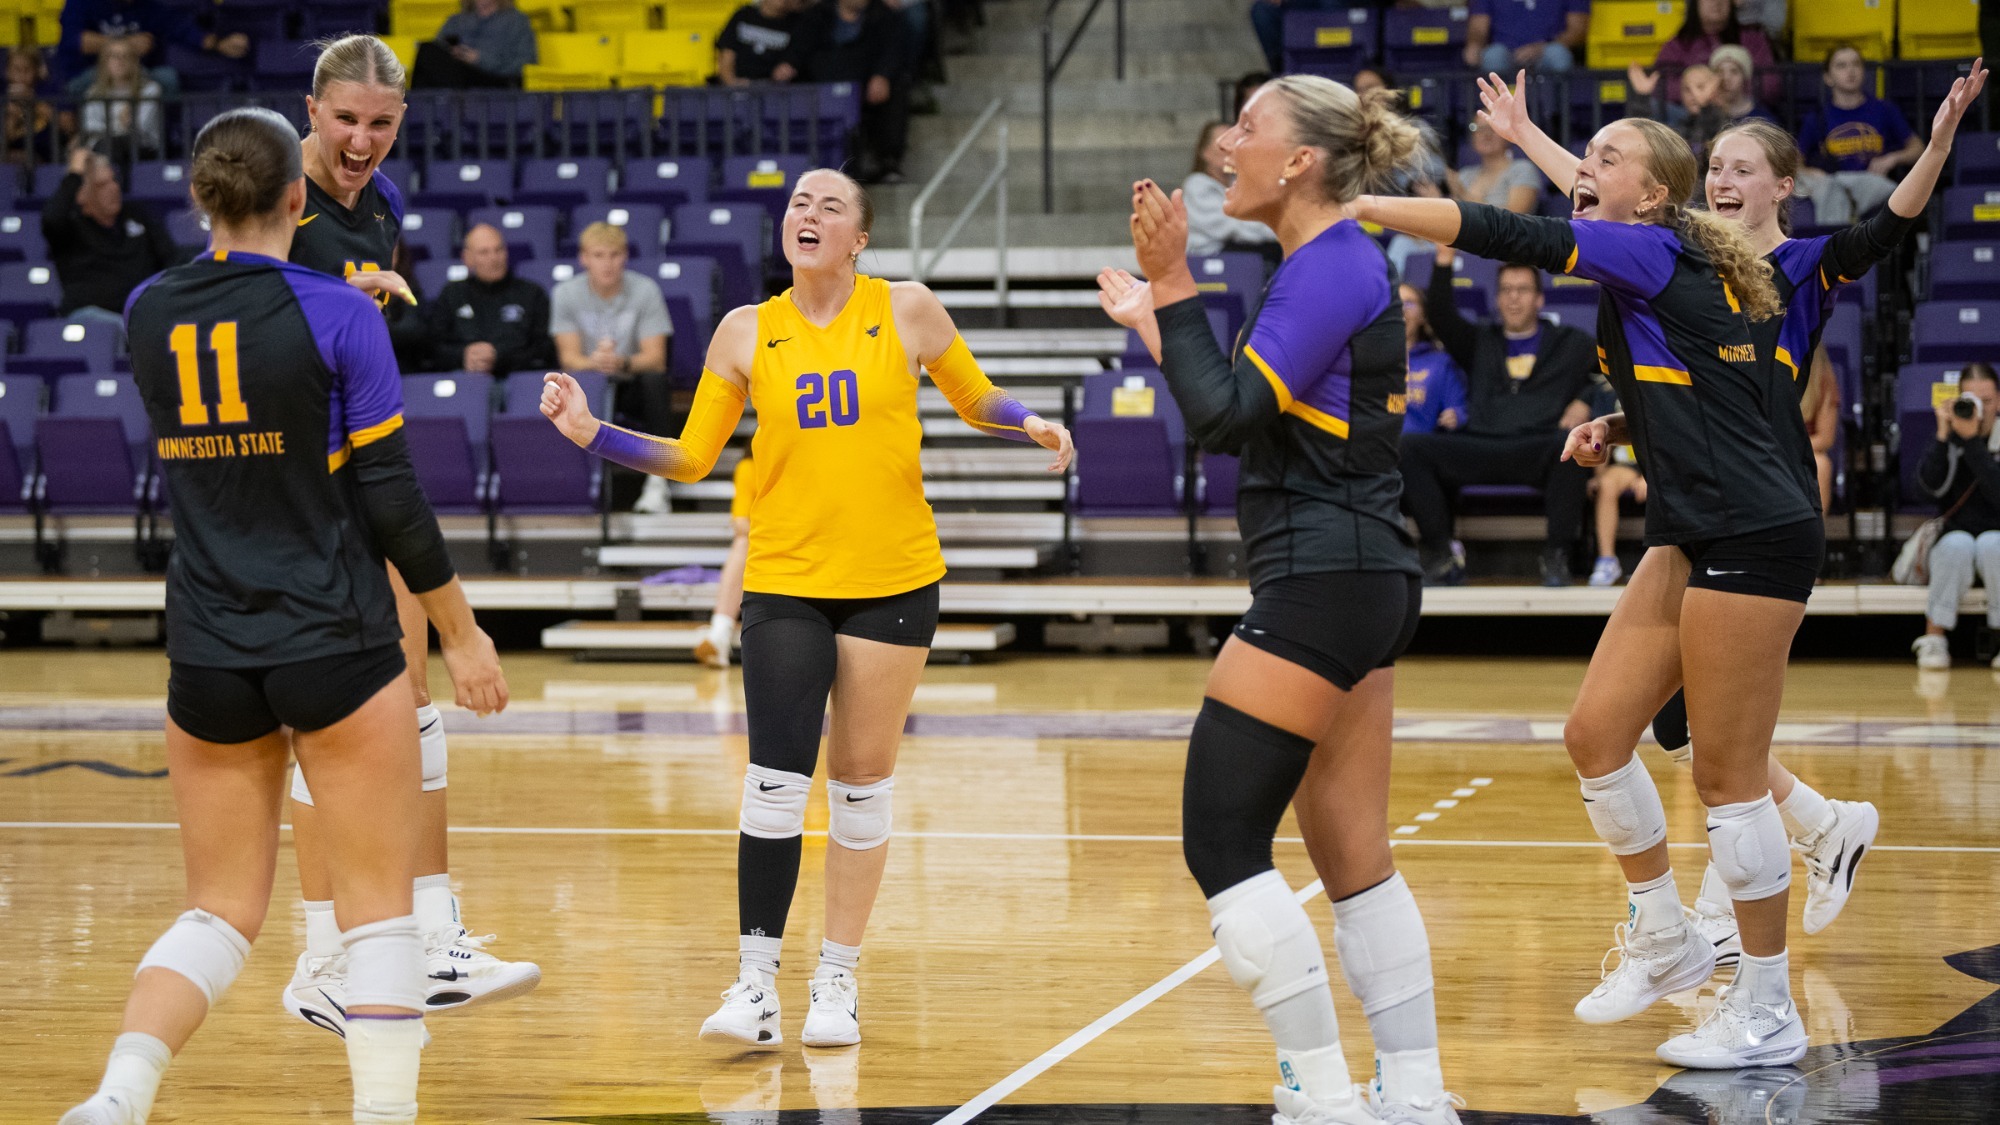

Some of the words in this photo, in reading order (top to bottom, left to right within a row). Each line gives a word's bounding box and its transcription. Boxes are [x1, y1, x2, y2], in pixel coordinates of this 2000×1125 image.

[169, 321, 249, 425] 11
[796, 369, 860, 430] 20
[238, 431, 285, 456] STATE
